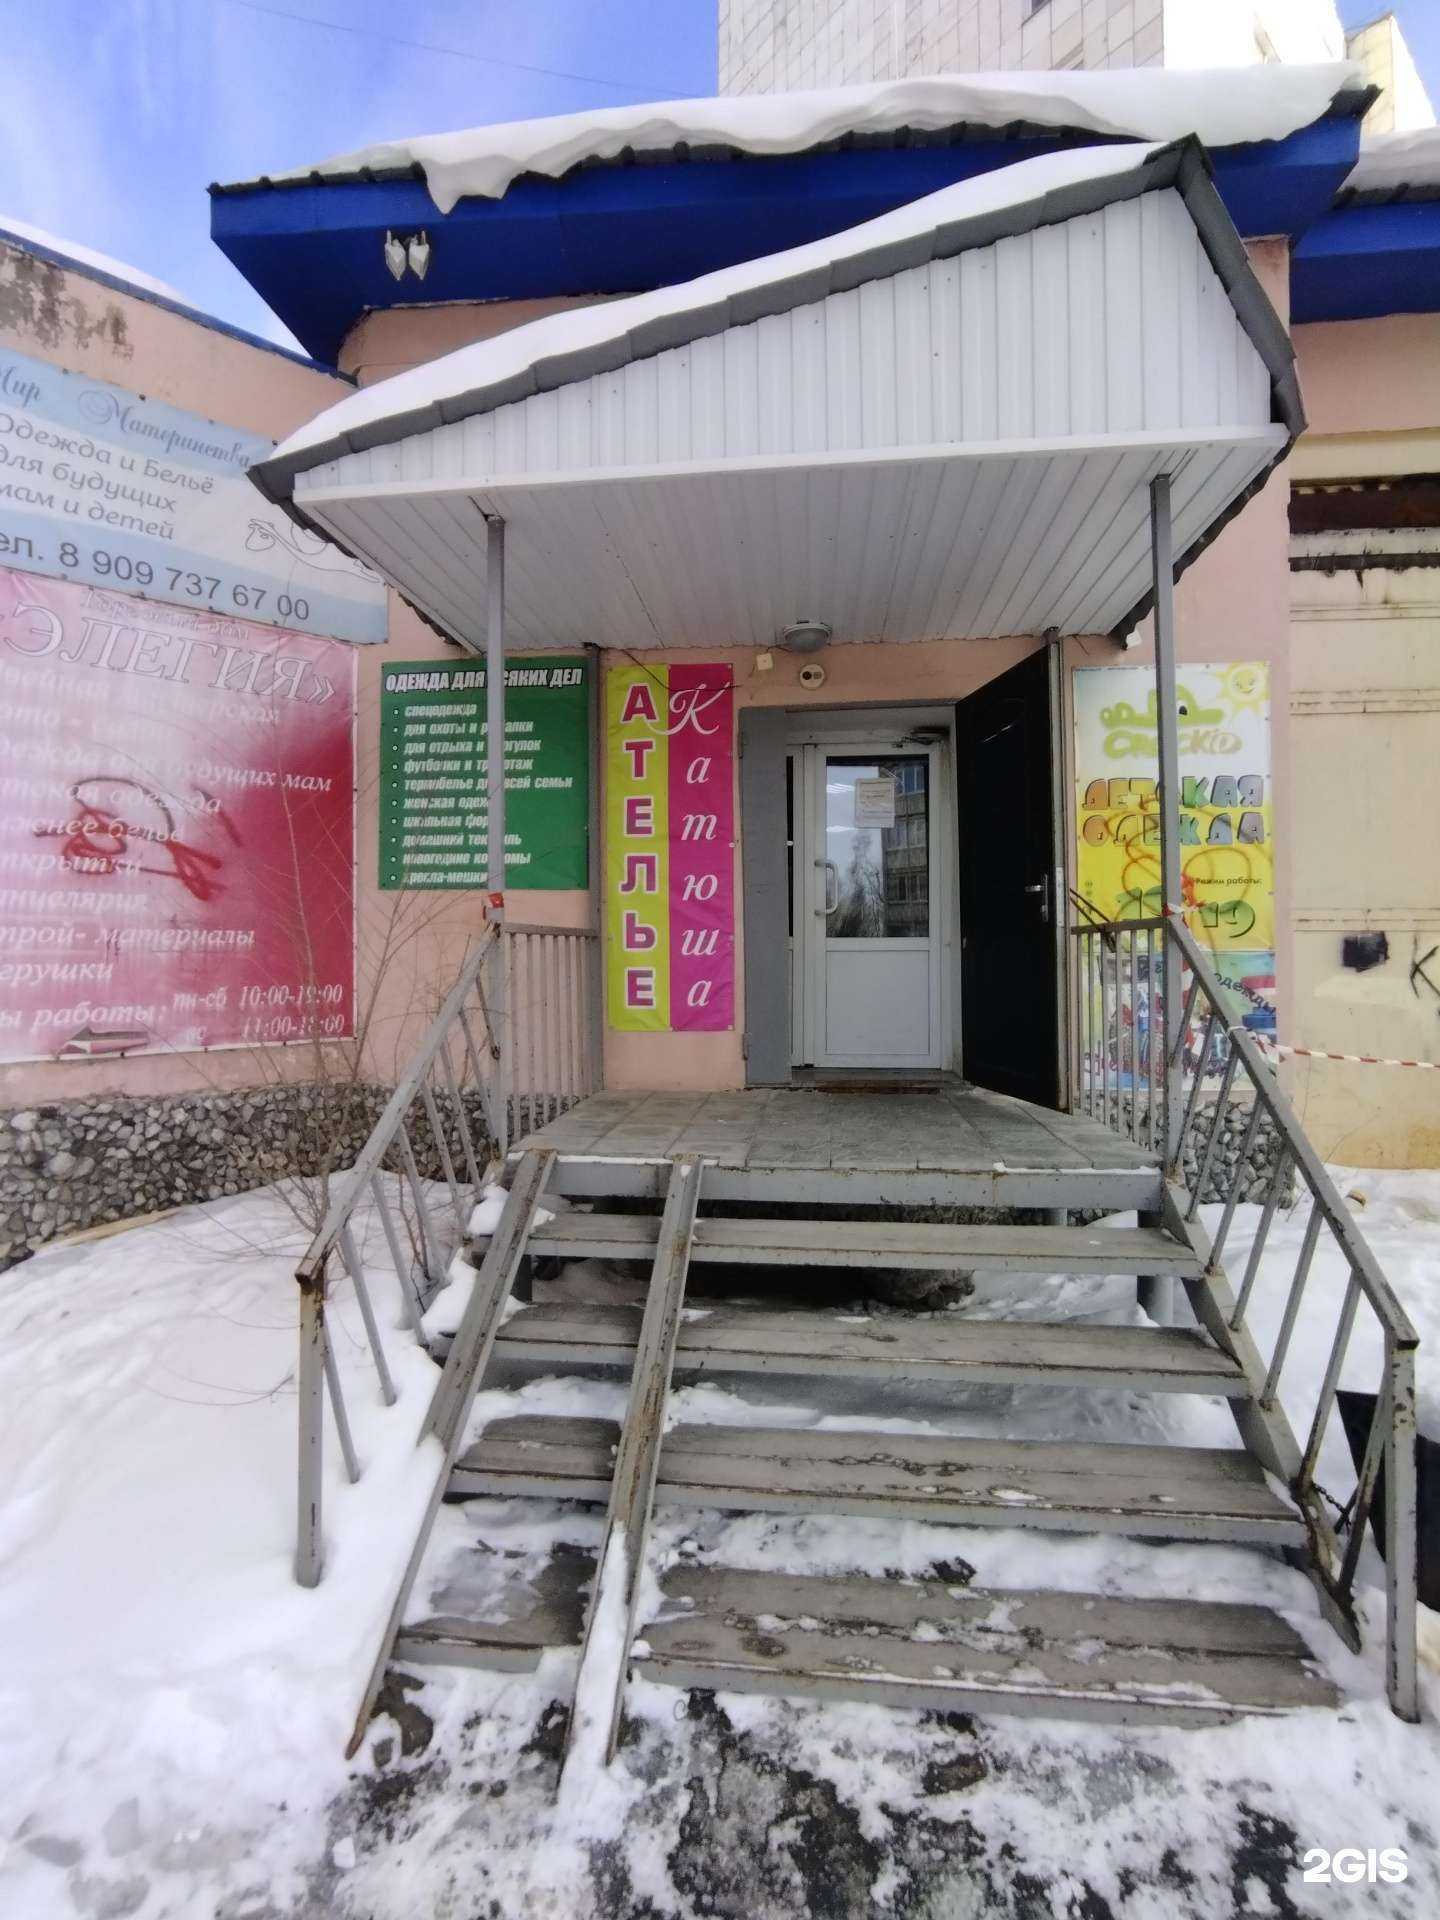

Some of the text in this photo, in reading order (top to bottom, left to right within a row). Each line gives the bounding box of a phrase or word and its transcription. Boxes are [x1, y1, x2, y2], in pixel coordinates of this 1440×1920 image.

[0, 412, 214, 494] Одежда и Бельё
[52, 462, 178, 512] будущих
[0, 484, 174, 540] мам и детей
[58, 542, 79, 568] 8
[92, 550, 154, 586] 909
[165, 568, 222, 600] 737
[231, 583, 267, 611] 67
[276, 594, 310, 621] 00
[0, 600, 336, 706] ЭЛЕГИЯ»
[385, 667, 583, 692] ОДЕЖДА ДЛЯ СЯКИХ ДЕЛ
[404, 704, 478, 718] спецодежда
[403, 720, 534, 737] для охоты и ралки
[403, 742, 427, 756] для
[476, 740, 486, 753] и
[464, 759, 473, 771] и
[476, 758, 534, 773] тротаж
[280, 772, 333, 792] мам
[534, 776, 573, 789] семьи
[1082, 774, 1265, 811] ДЕТКАЯ
[457, 796, 490, 810] одеж
[465, 813, 503, 829] фор
[468, 833, 523, 847] текиль
[619, 682, 659, 1009] АТЕЛЬЕ
[656, 681, 730, 1009] Катюша
[94, 926, 257, 953] материалы
